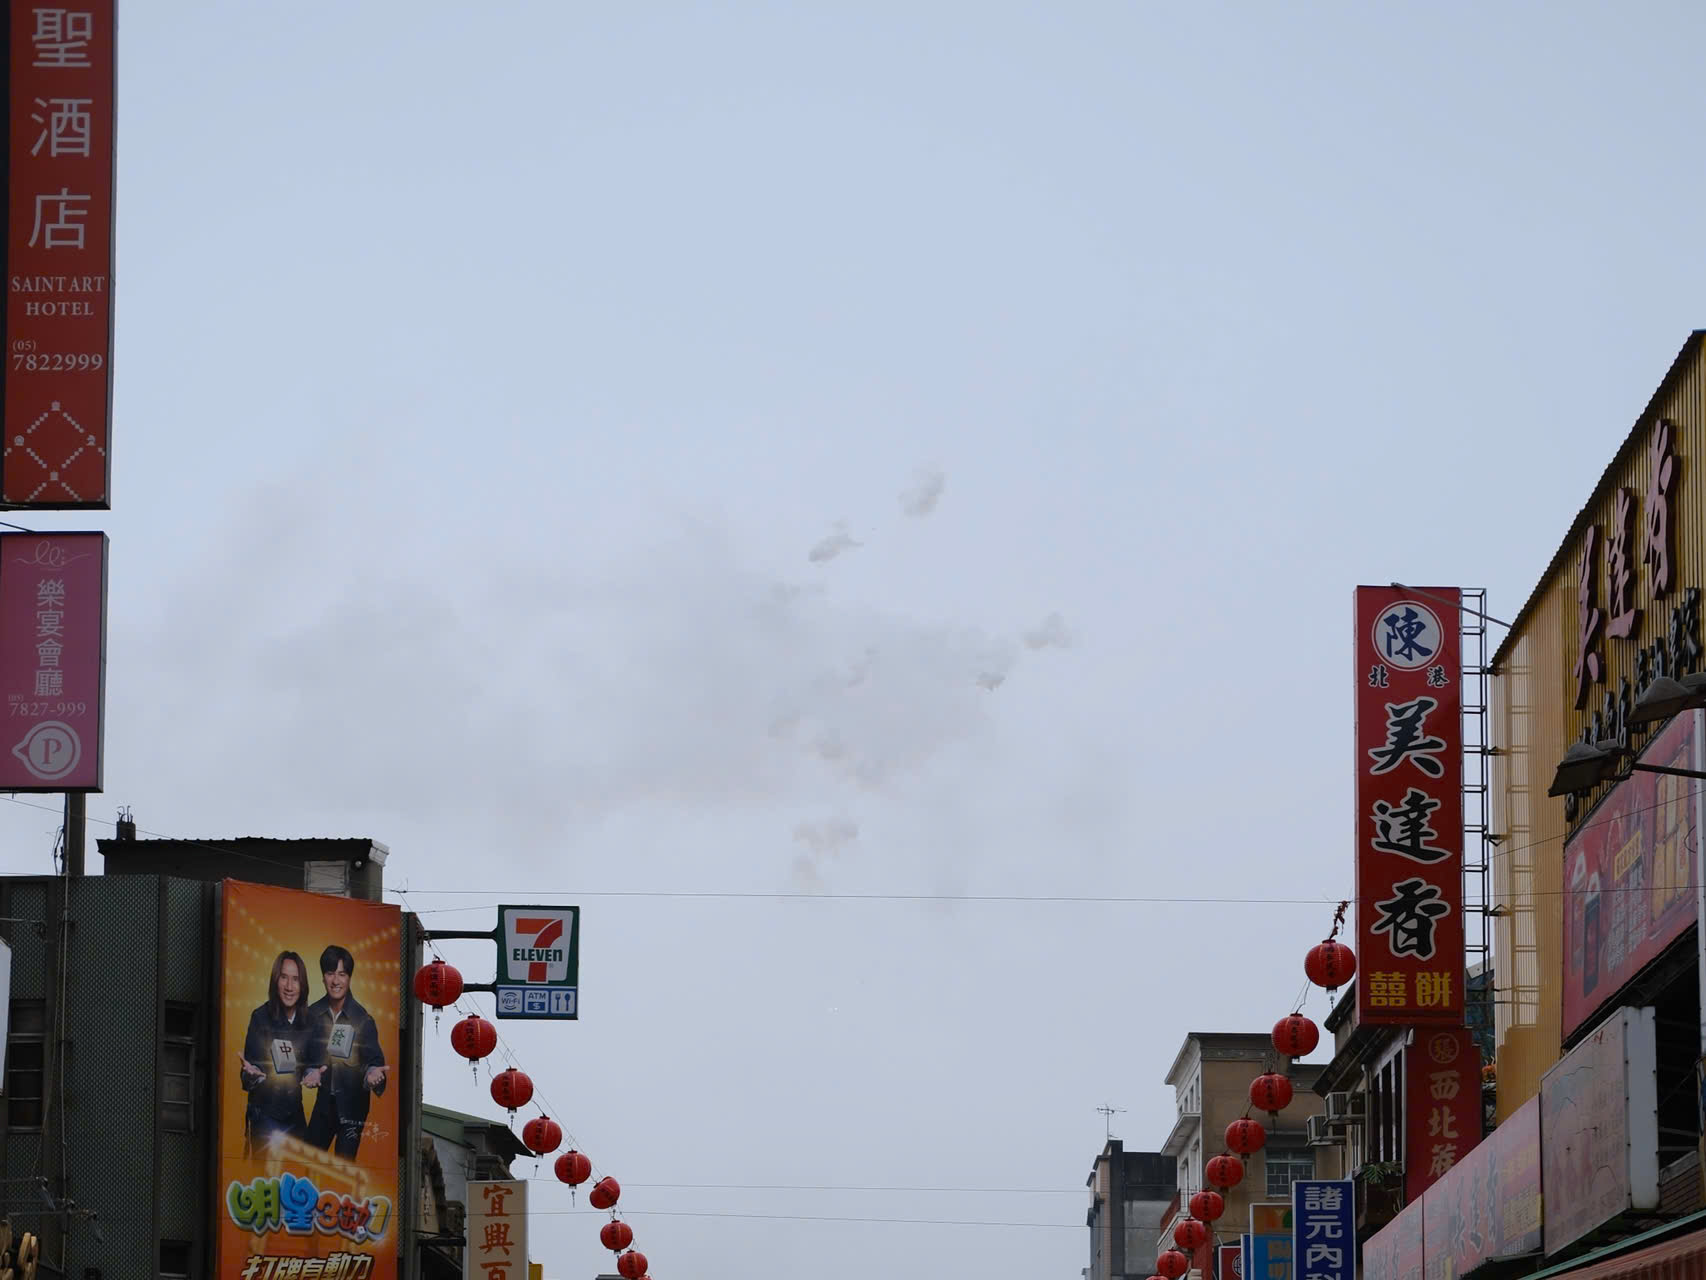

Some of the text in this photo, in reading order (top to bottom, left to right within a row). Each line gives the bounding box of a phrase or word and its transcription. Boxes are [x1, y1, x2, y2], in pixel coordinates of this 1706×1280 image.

[28, 8, 93, 249] 聖酒店
[12, 276, 105, 293] SAINT ART
[25, 301, 94, 316] HOTEL
[12, 340, 37, 352] (05)
[13, 353, 103, 371] 7822999
[34, 579, 65, 697] 樂宴會廳
[1383, 606, 1433, 661] 陳
[1368, 664, 1450, 688] 北港
[9, 702, 87, 717] 7827-999
[1367, 696, 1453, 962] 美達香
[527, 992, 547, 1000] ATM
[1369, 971, 1453, 1008] 囍餅
[279, 1041, 292, 1060] 中
